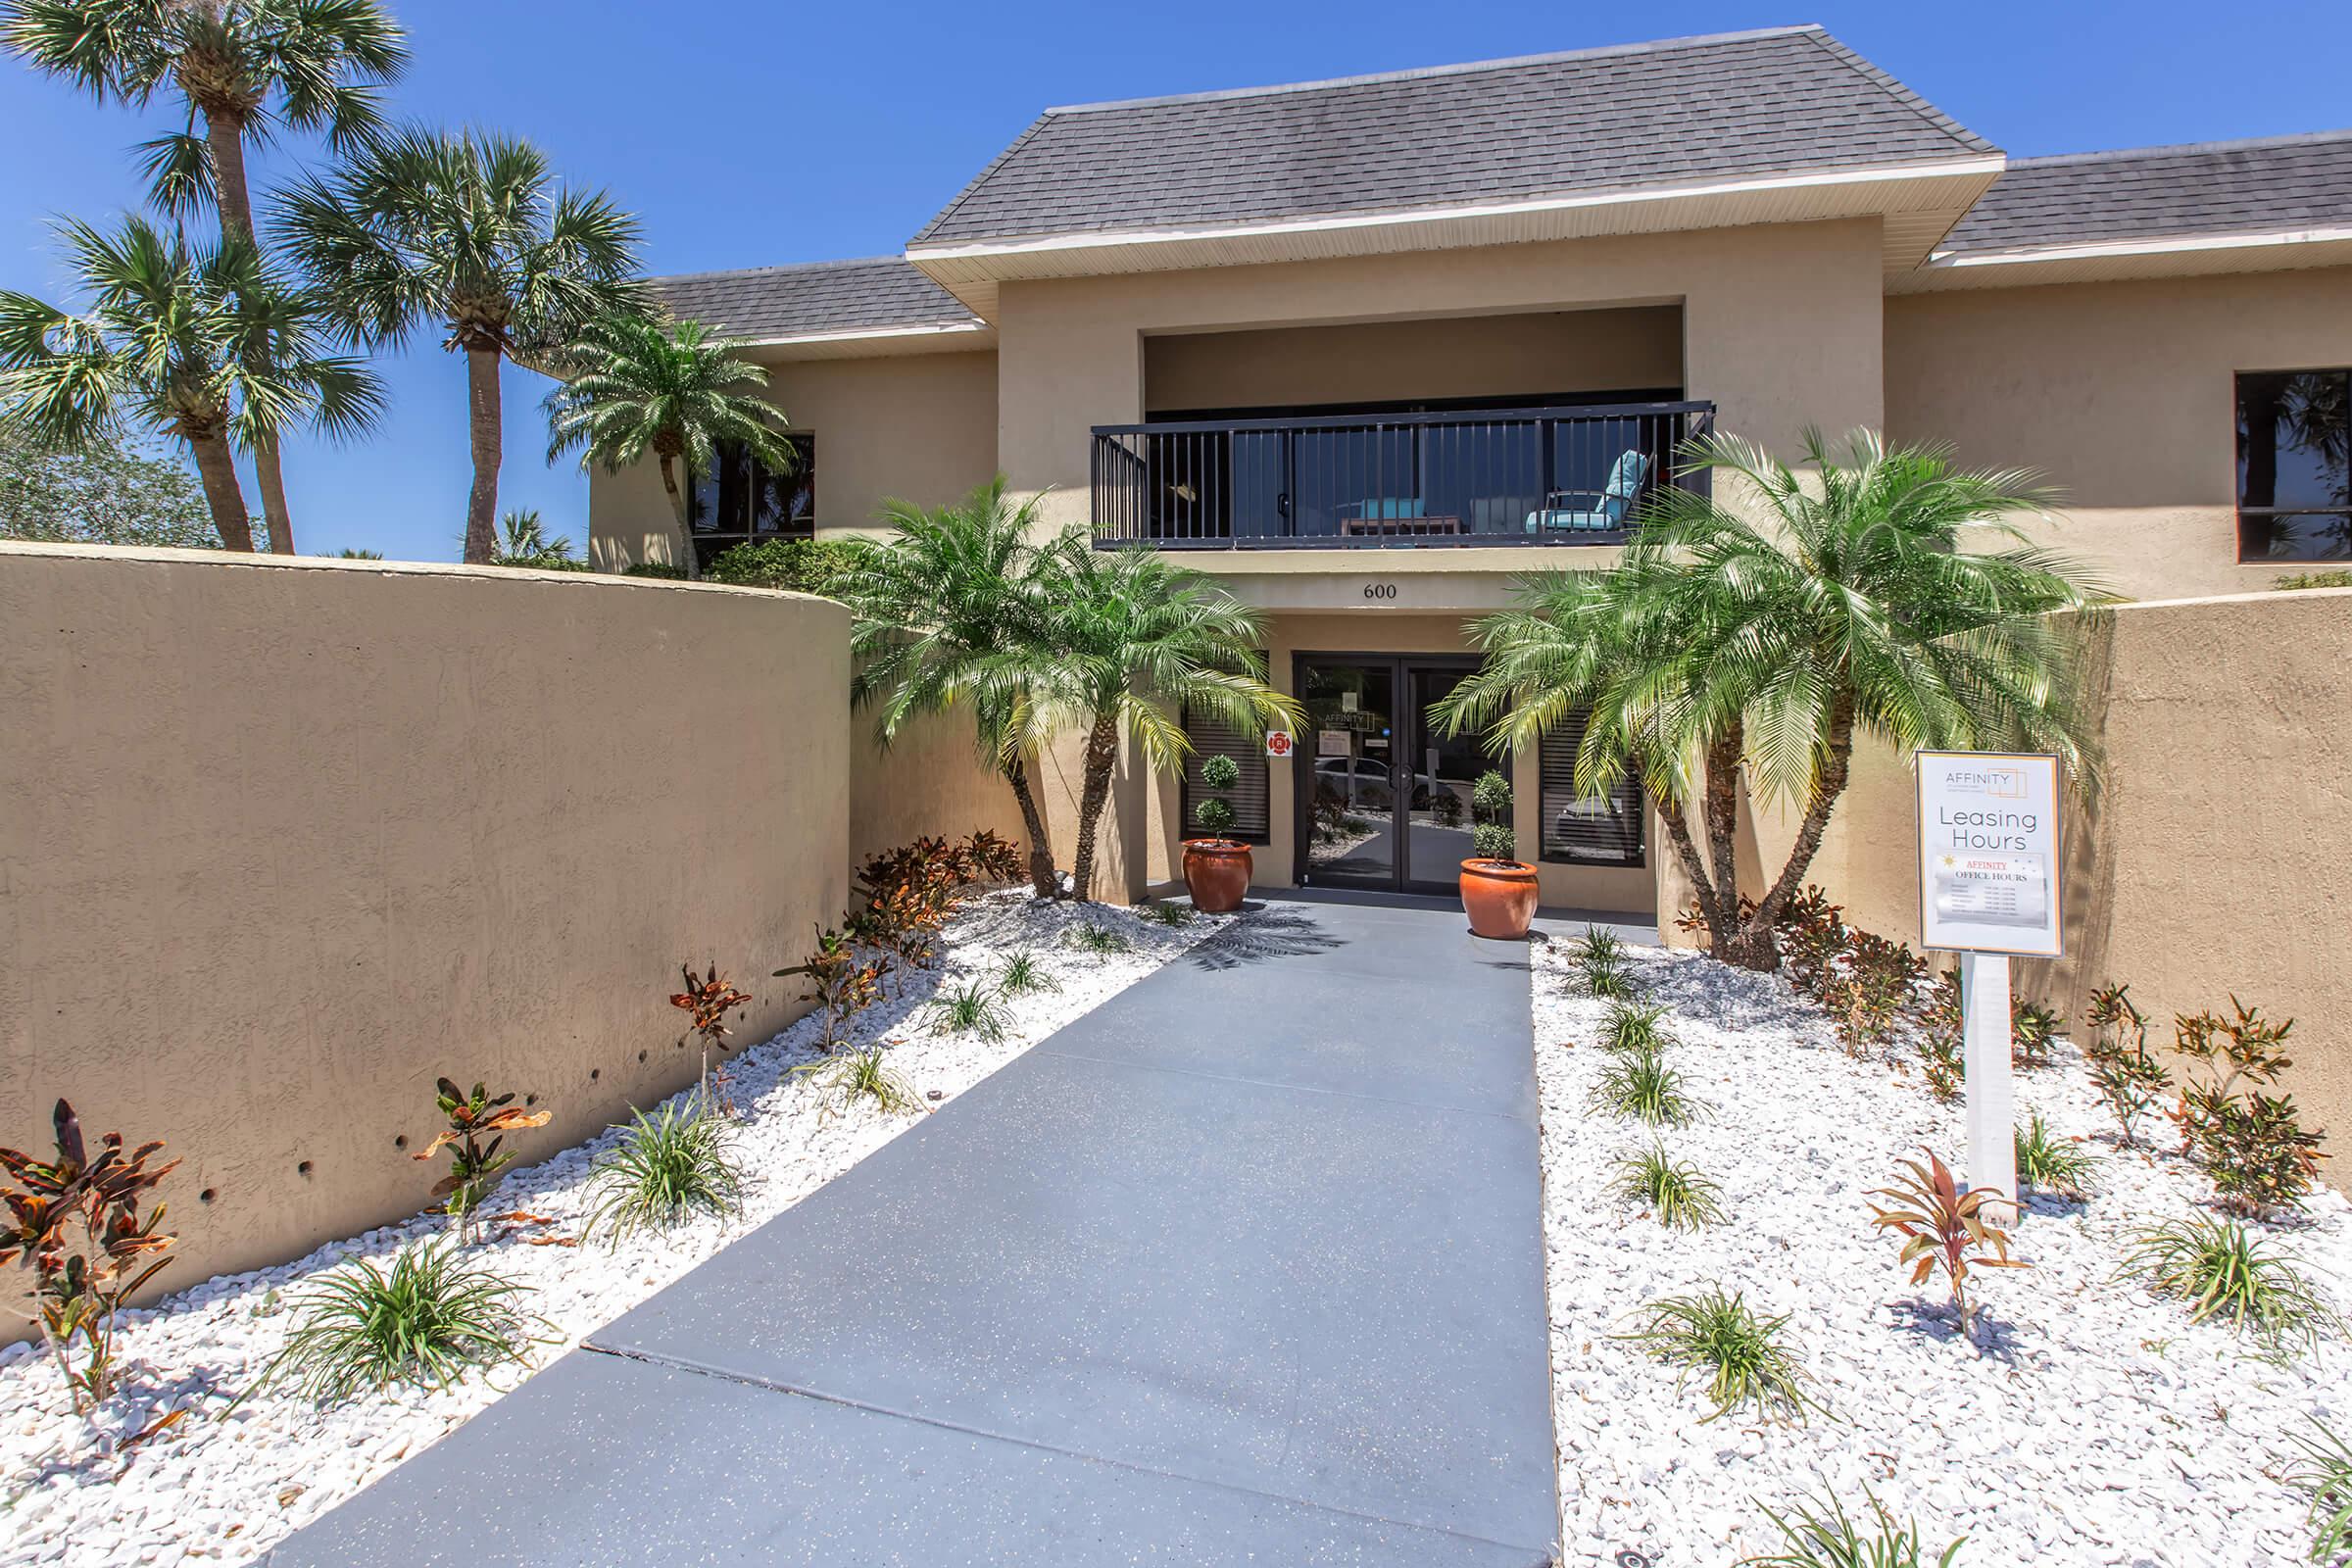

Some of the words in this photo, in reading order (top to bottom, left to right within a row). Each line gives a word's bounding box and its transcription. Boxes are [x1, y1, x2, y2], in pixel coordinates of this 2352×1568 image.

[1363, 584, 1396, 599] 600
[1325, 713, 1364, 722] AFFINITY
[1946, 772, 2010, 784] AFFINITY
[1940, 807, 2036, 833] Leasing
[1953, 829, 2027, 850] Hours
[1967, 860, 2007, 870] AFFINITY
[1955, 870, 1991, 880] OFFICE
[1992, 872, 2028, 882] HOURS
